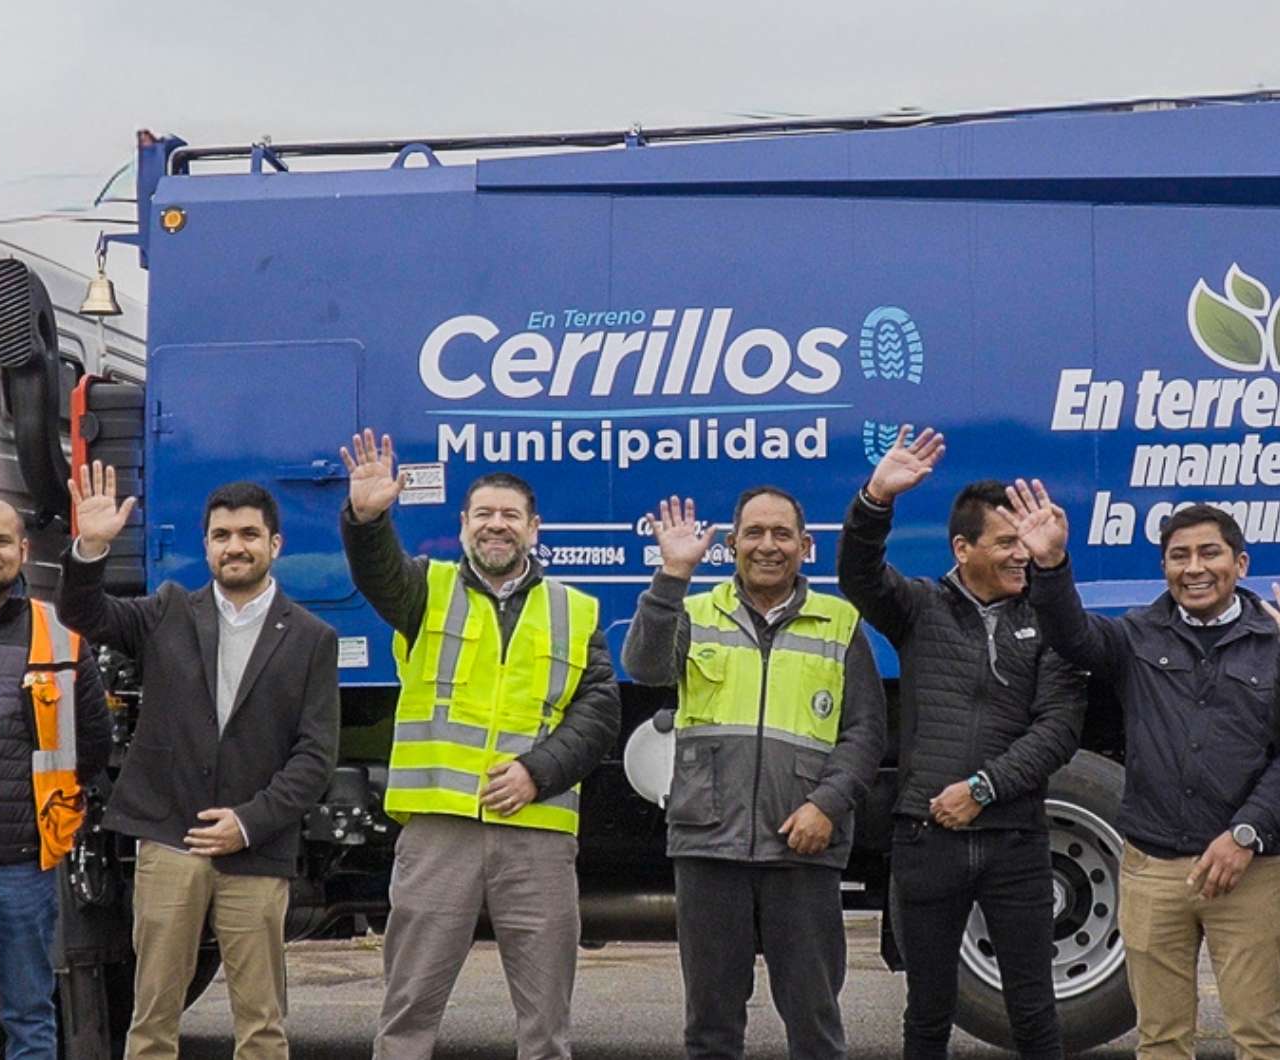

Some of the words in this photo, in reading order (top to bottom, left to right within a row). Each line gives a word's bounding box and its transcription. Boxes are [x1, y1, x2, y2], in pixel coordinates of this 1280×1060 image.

[527, 311, 556, 330] En
[564, 309, 646, 328] Terreno
[418, 307, 849, 400] Cerrillos
[1050, 368, 1125, 431] En
[437, 417, 828, 469] Municipalidad
[1087, 491, 1136, 546] la
[551, 545, 626, 566] 233278194
